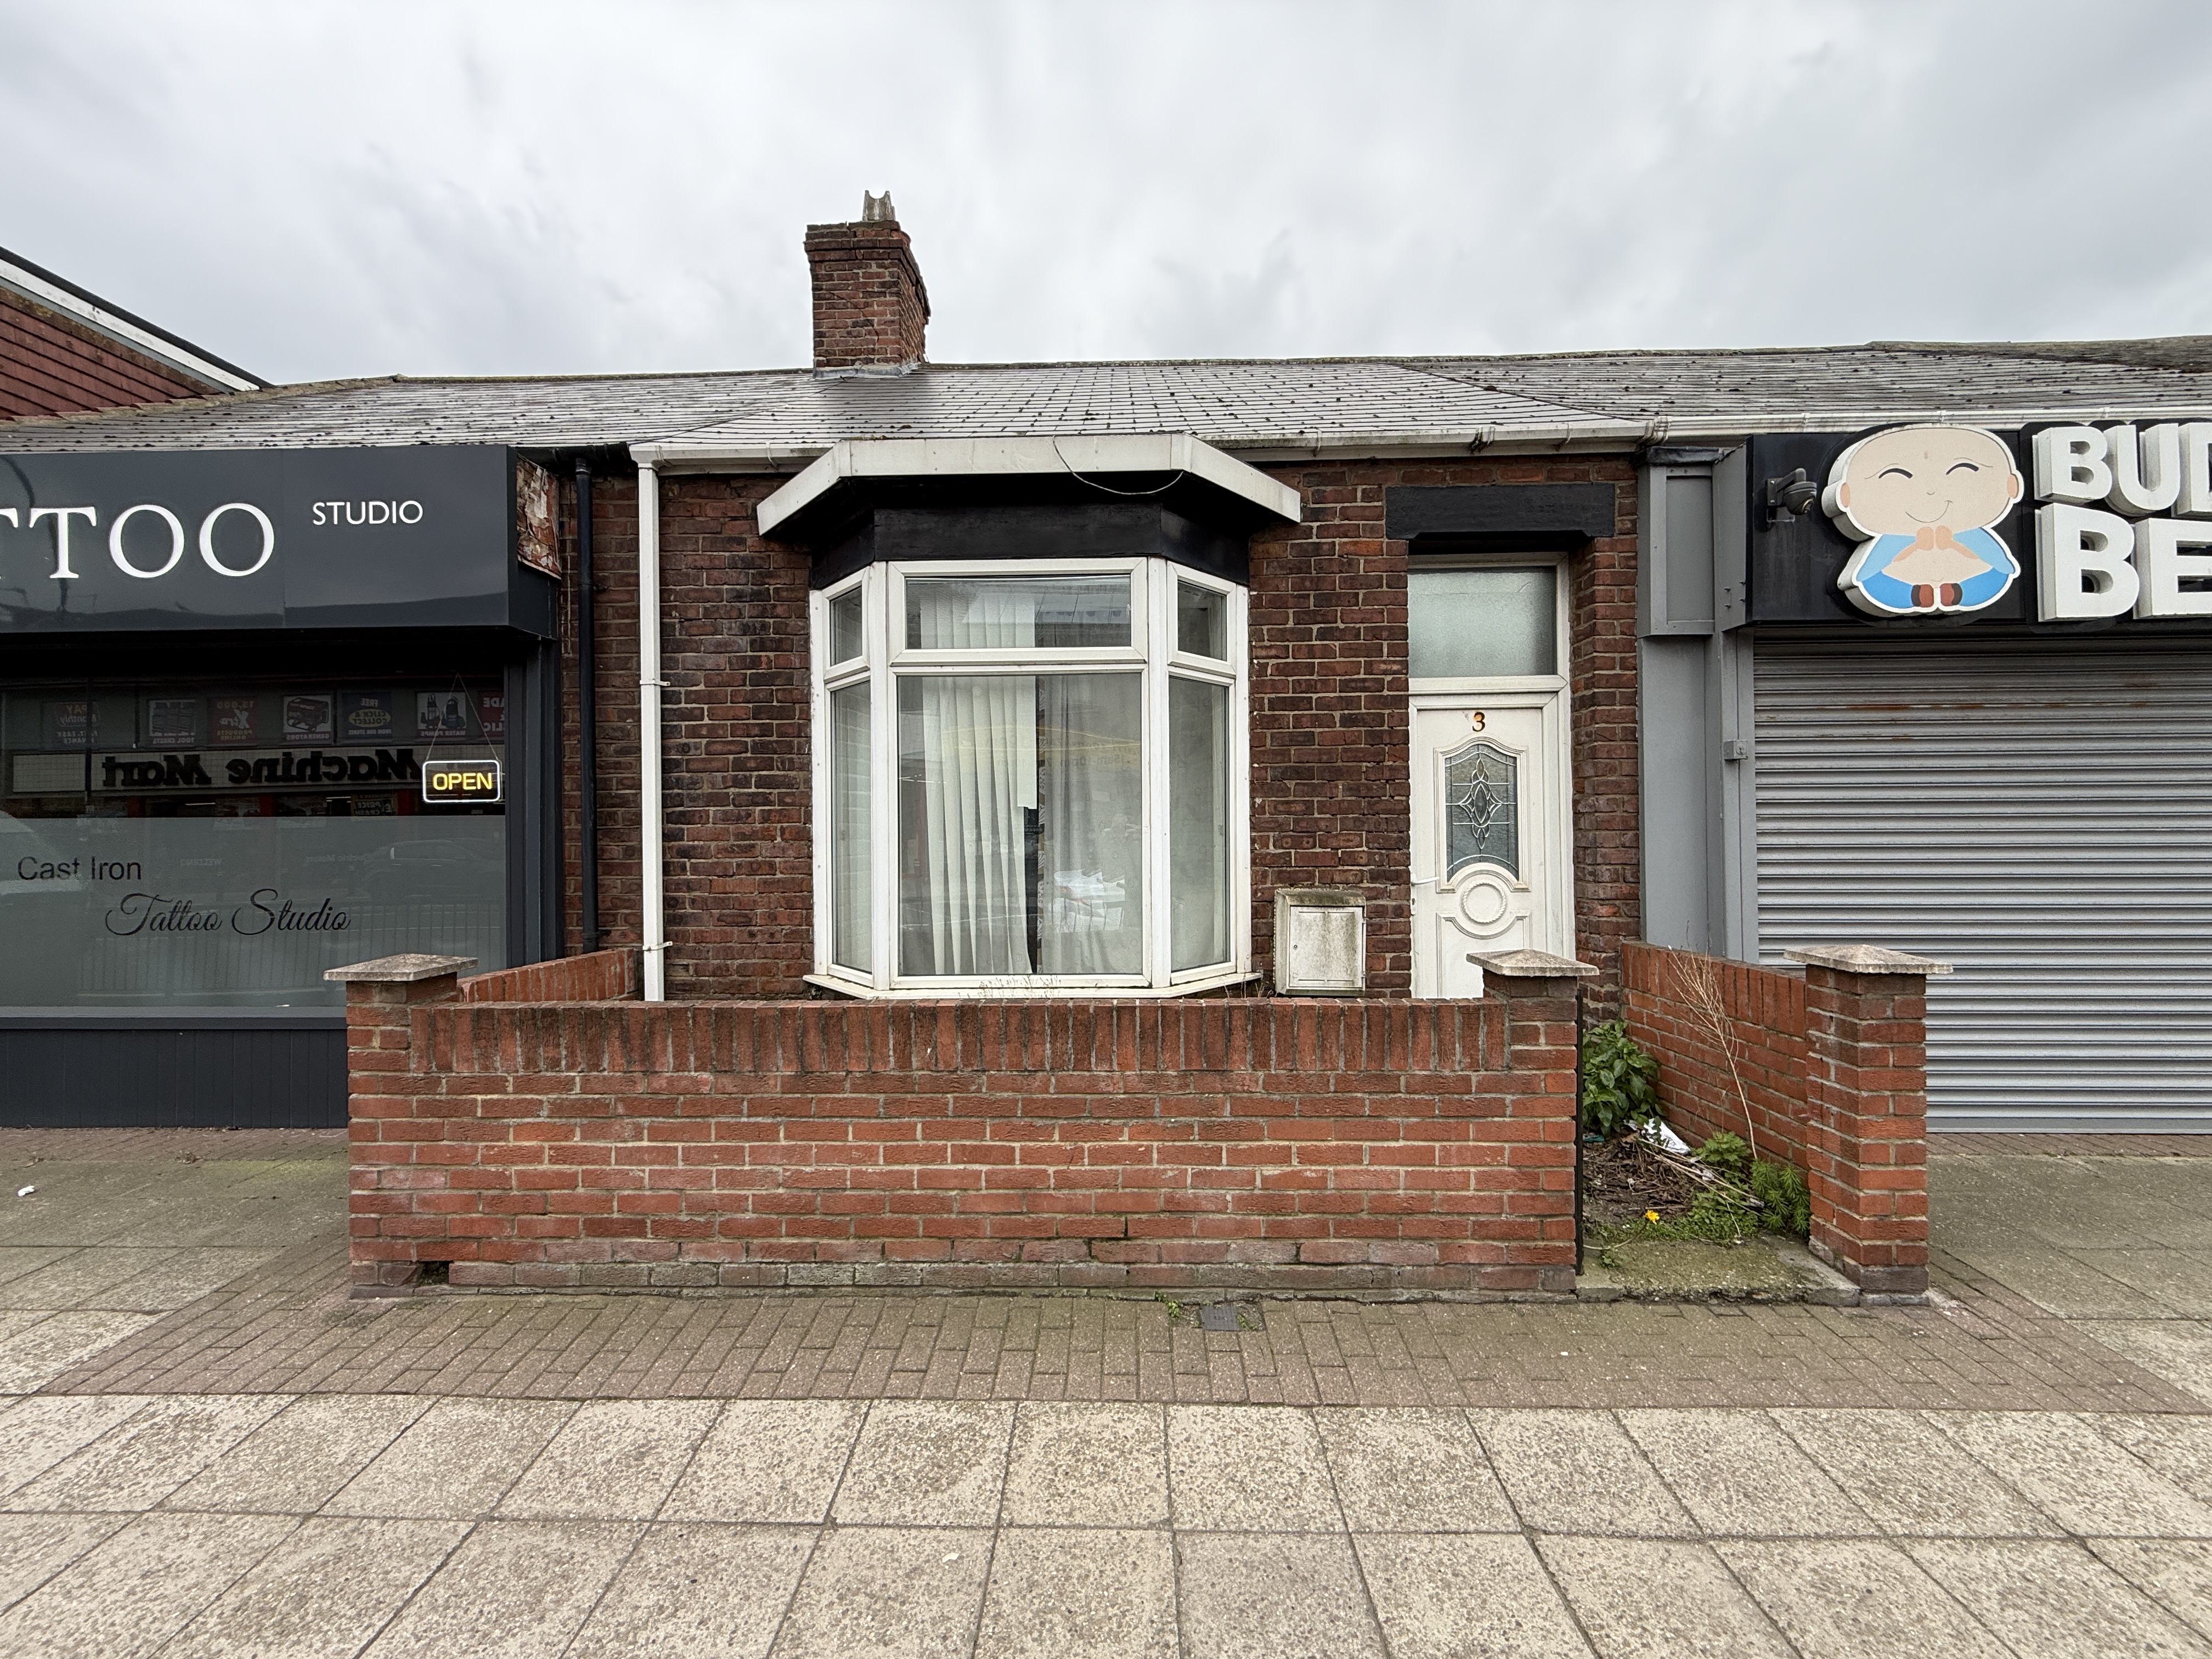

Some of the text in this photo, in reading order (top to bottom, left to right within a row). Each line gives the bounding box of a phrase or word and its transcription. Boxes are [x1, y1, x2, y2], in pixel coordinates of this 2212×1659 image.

[312, 500, 424, 526] STUDIO
[0, 503, 275, 579] TOO
[2035, 502, 2212, 622] BE
[1472, 712, 1486, 732] 3
[432, 772, 493, 791] OPEN
[18, 856, 142, 881] Cast Iron
[105, 888, 352, 936] Tattoo Studio
